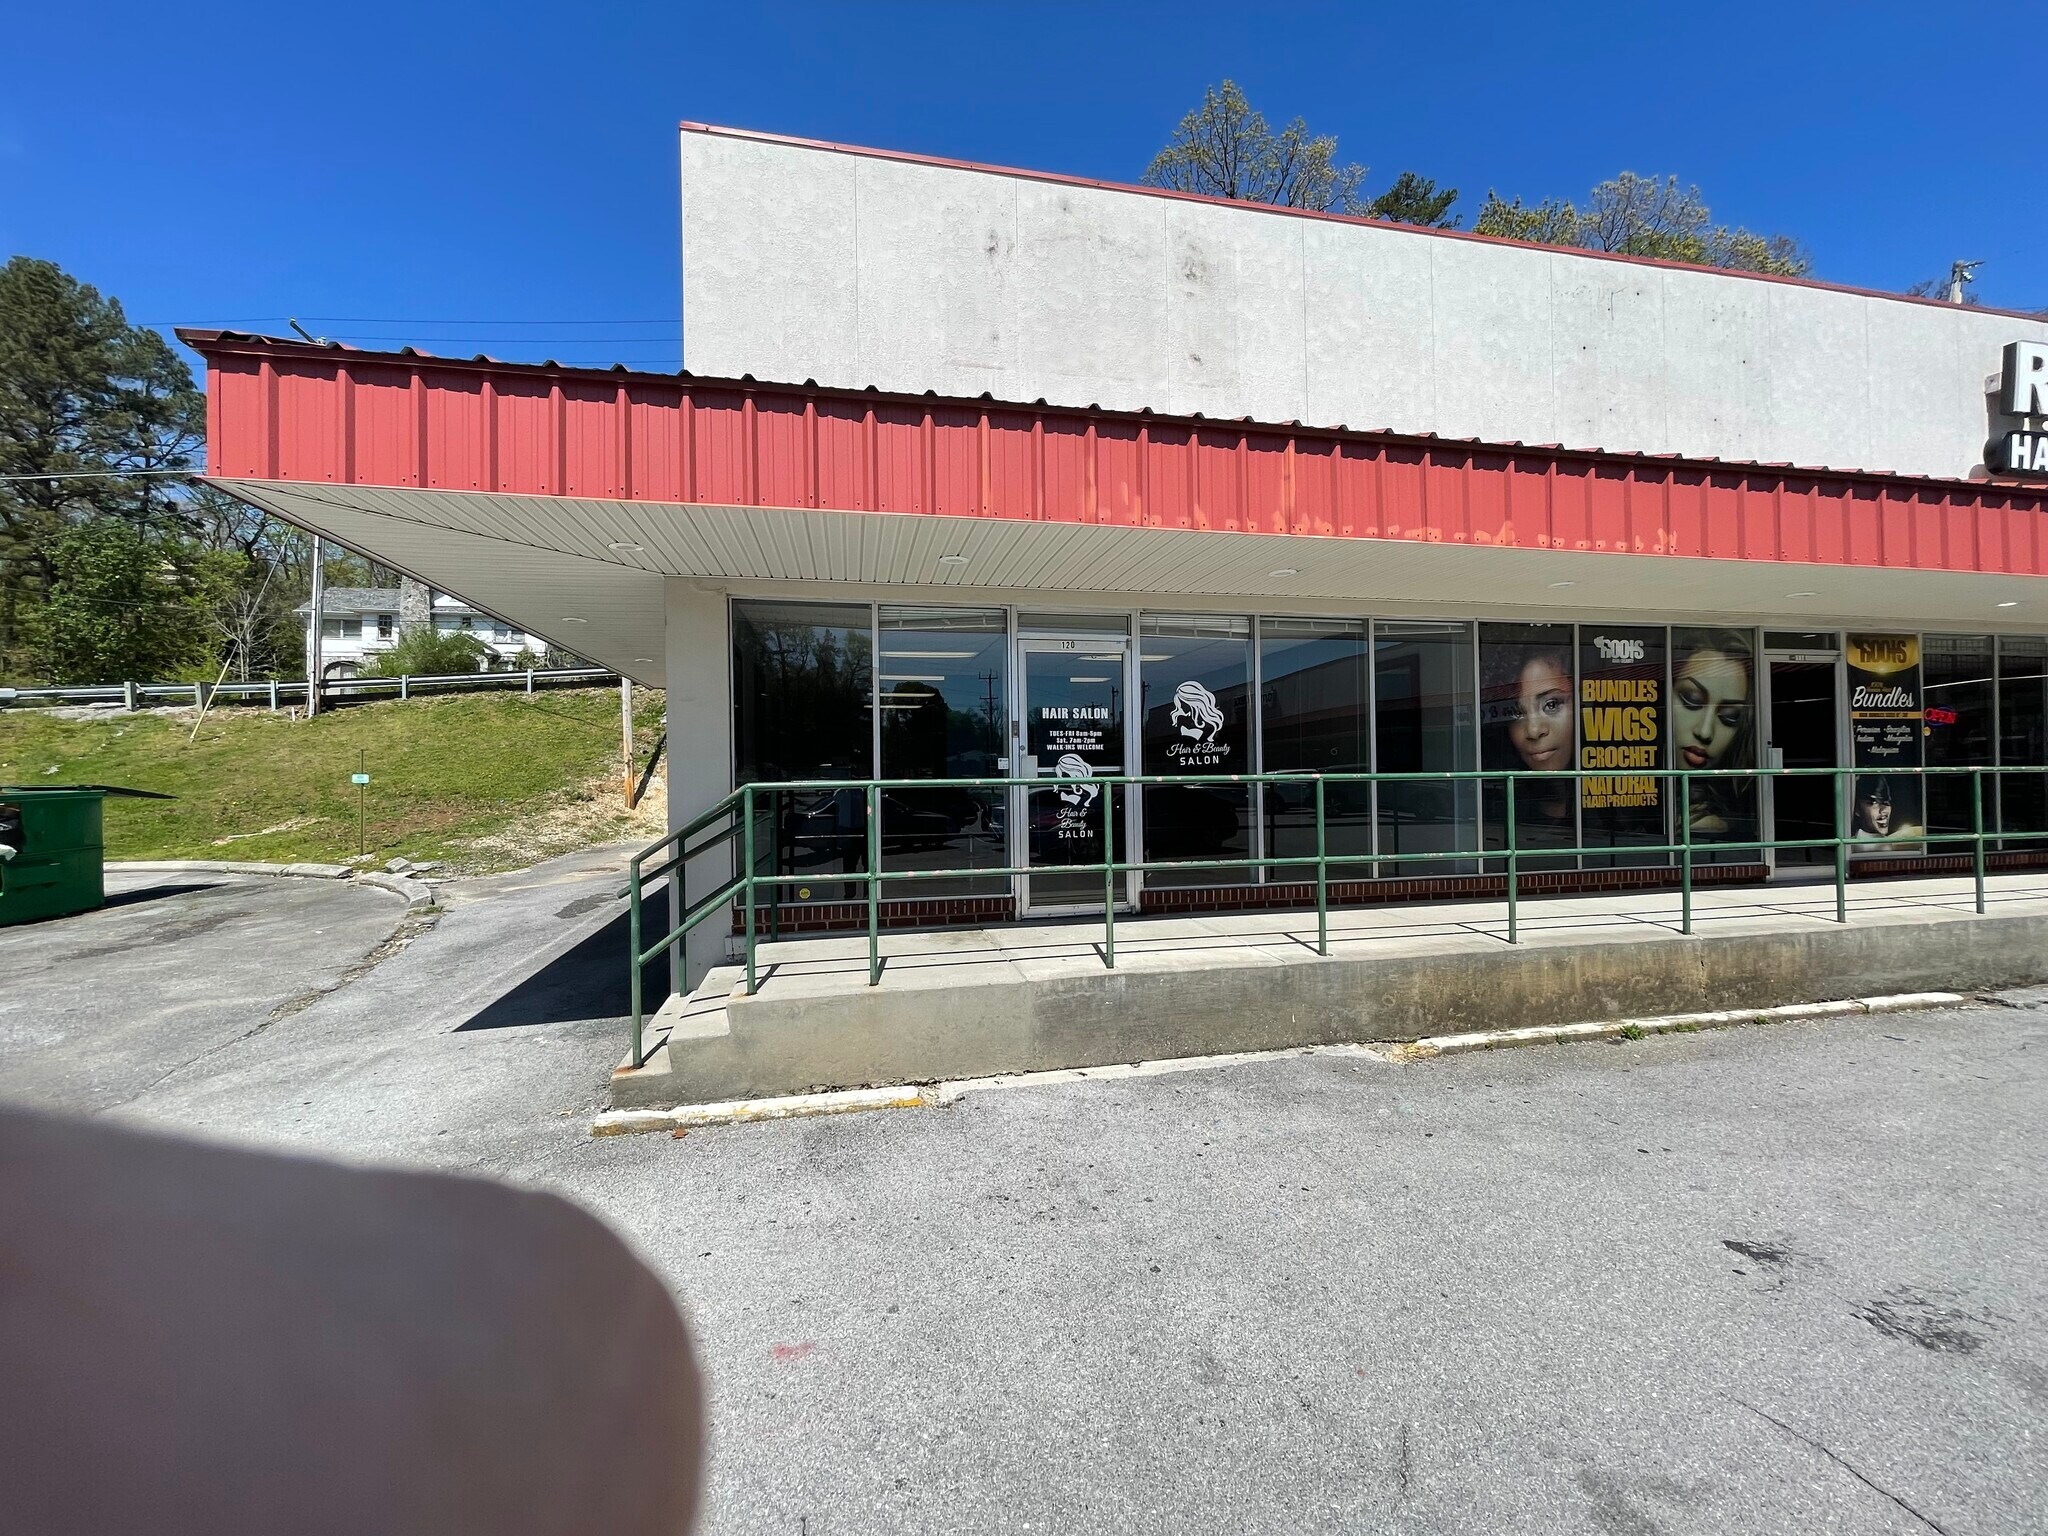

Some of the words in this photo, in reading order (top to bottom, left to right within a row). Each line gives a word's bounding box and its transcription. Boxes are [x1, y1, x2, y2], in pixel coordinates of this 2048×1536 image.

[1061, 641, 1075, 649] 120
[1582, 680, 1658, 702] BUNDLES
[1852, 685, 1914, 708] Bundles
[1042, 707, 1069, 719] HAIR
[1072, 707, 1109, 719] SALON
[1582, 707, 1658, 741] WIGS
[1166, 742, 1191, 756] Hair
[1192, 743, 1202, 754] &
[1202, 742, 1231, 755] Beauty
[1179, 755, 1219, 766] SALON
[1582, 746, 1658, 768] CROCHET
[1582, 776, 1658, 795] NATURAL
[1582, 794, 1606, 808] HAIR
[1605, 793, 1658, 808] PRODUCTS
[1056, 807, 1079, 819] Hair
[1079, 808, 1087, 818] &
[1060, 820, 1086, 830] Beauty
[1058, 829, 1094, 839] SALON
